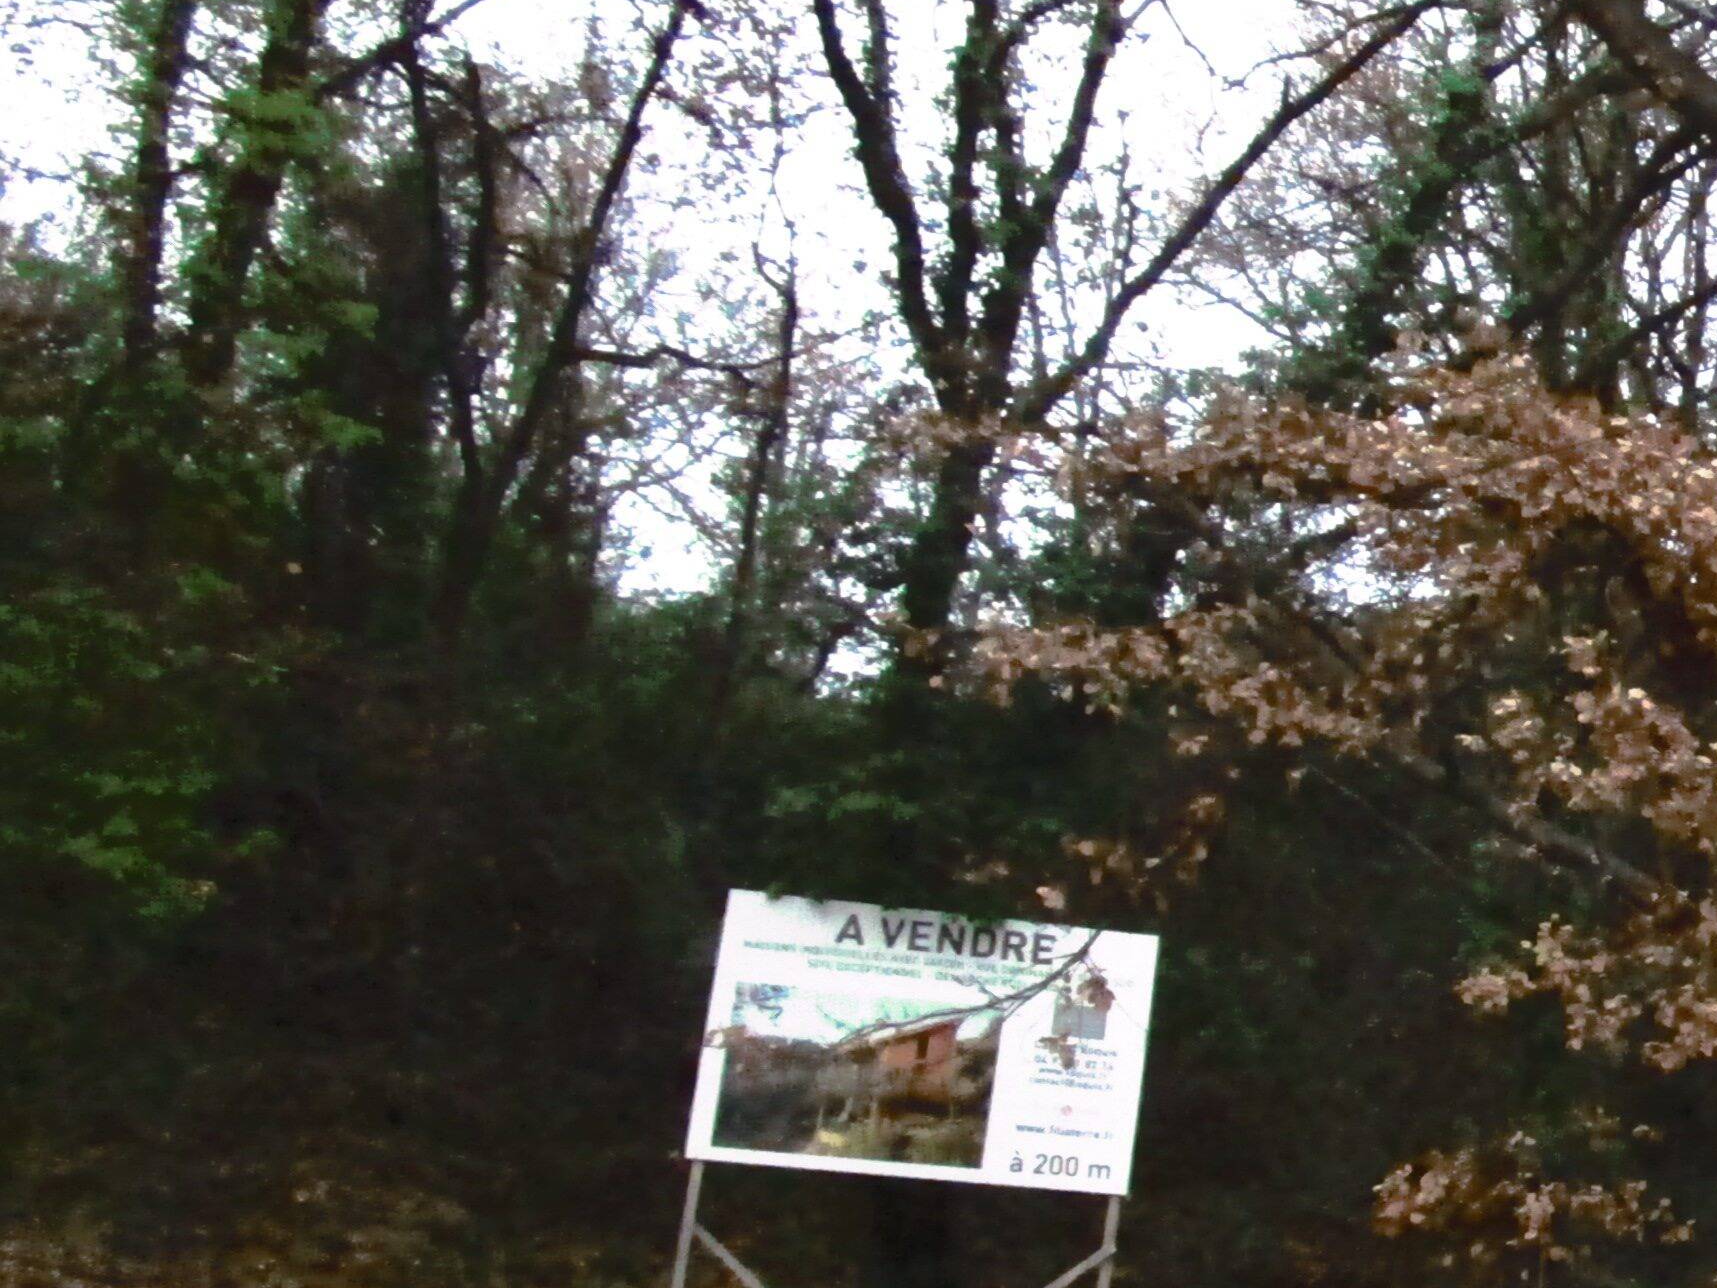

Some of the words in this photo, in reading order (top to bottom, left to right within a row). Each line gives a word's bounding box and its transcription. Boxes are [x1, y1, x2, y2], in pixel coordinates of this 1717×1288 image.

[835, 913, 865, 946] A
[881, 918, 1057, 966] VENDRE
[1009, 1150, 1023, 1173] à
[1033, 1153, 1079, 1177] 200
[1088, 1163, 1111, 1179] m
